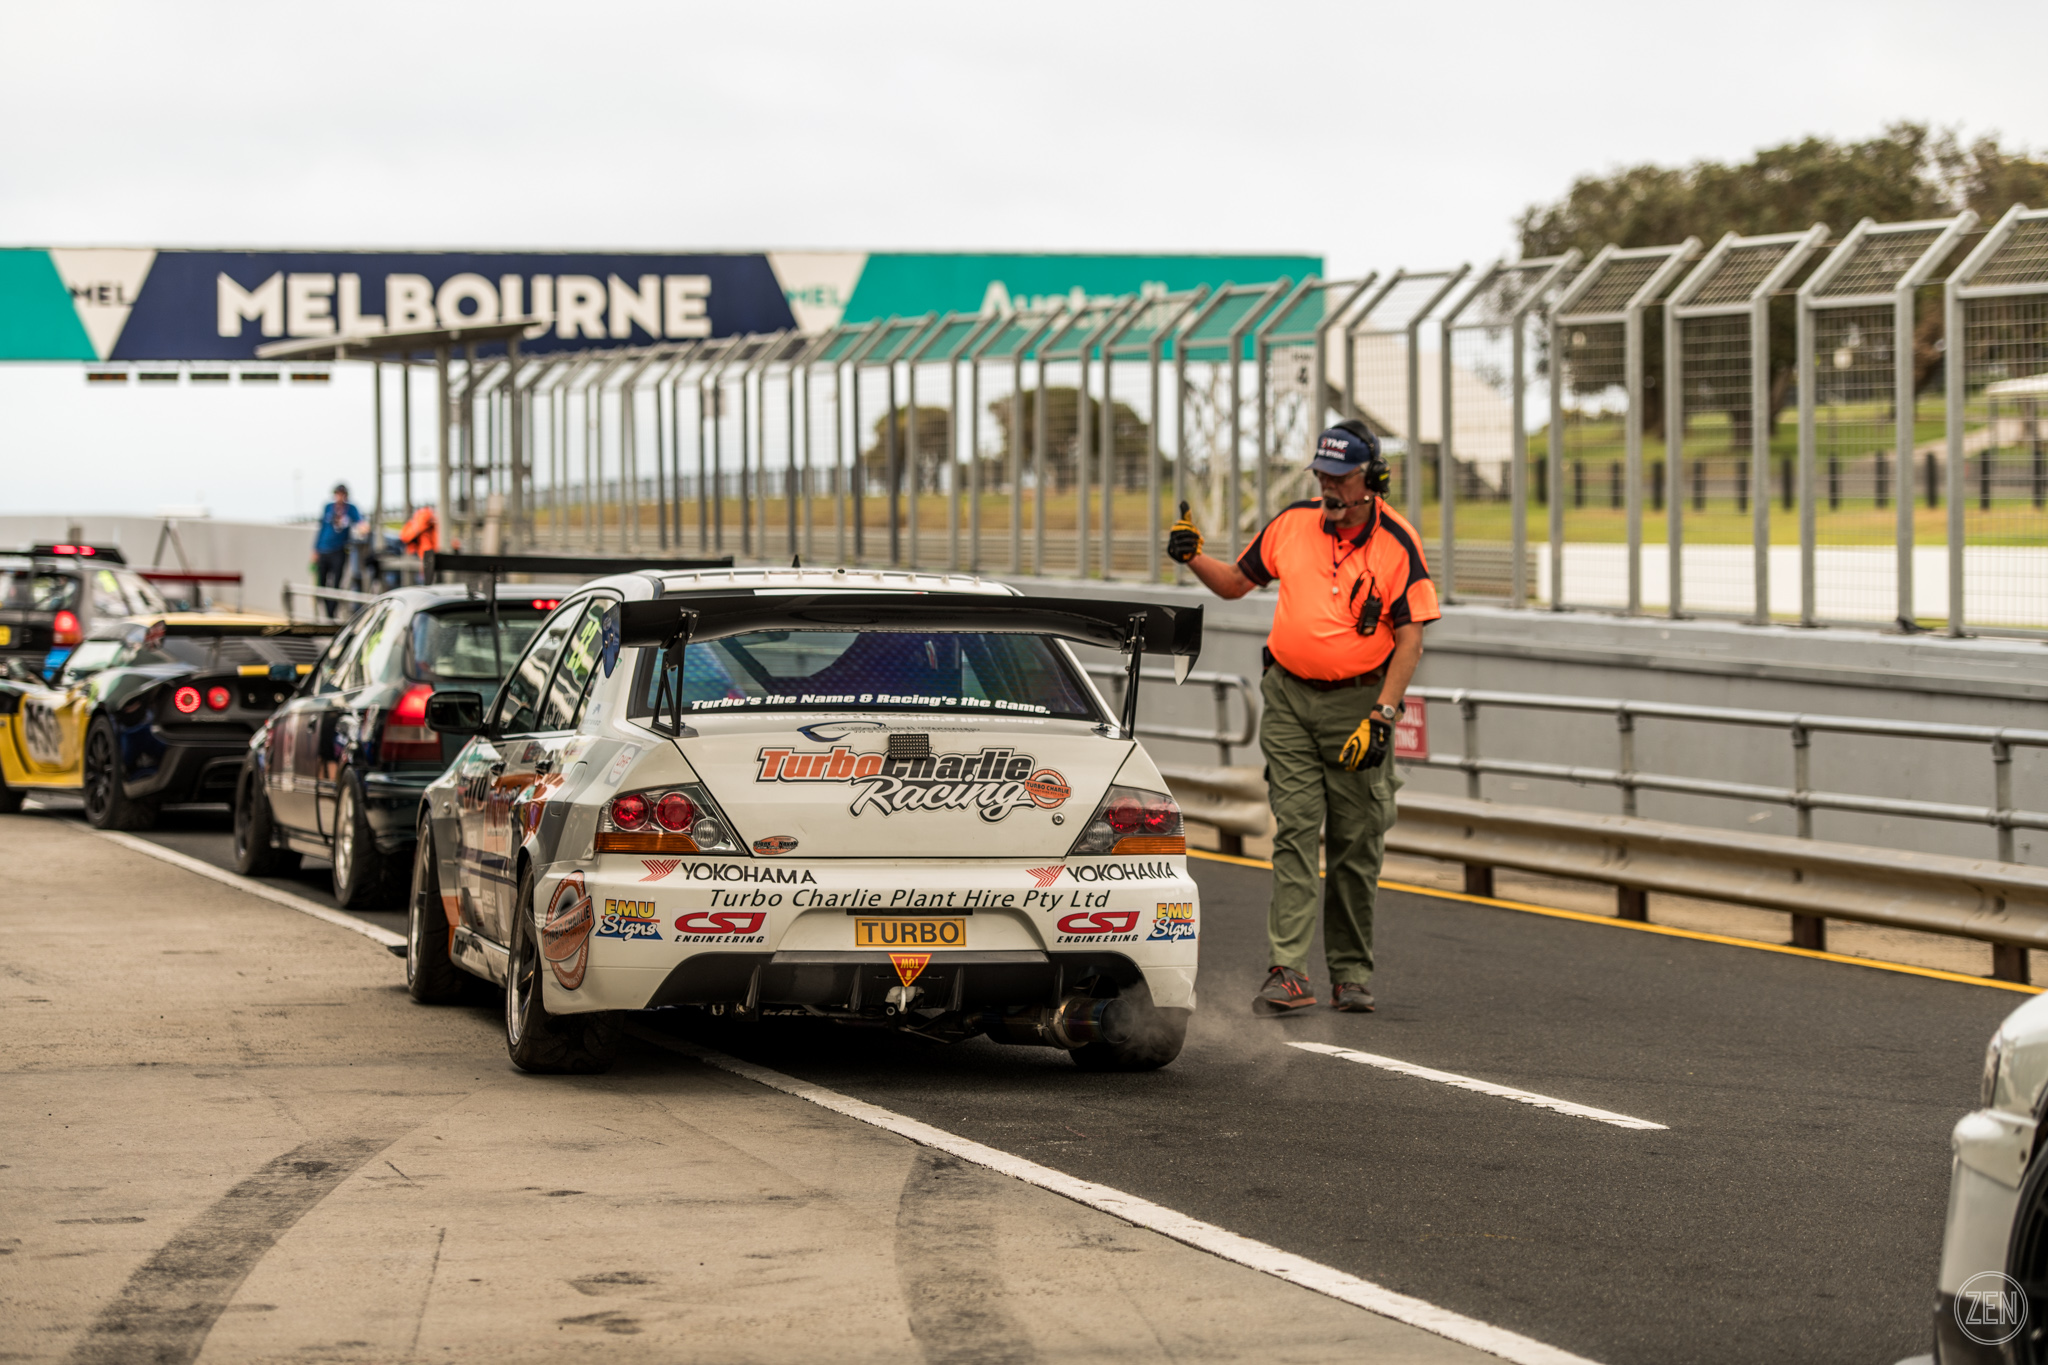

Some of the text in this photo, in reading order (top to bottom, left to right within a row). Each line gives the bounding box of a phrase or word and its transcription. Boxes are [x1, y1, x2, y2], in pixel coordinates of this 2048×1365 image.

[68, 283, 136, 307] MEL
[216, 270, 713, 339] MELBOURNE
[691, 696, 762, 710] Turbo's
[765, 695, 797, 704] the
[800, 694, 856, 703] Name
[876, 694, 957, 707] Racing's
[960, 697, 991, 708] the
[995, 699, 1051, 714] Game.
[850, 773, 1036, 822] Racing
[1026, 782, 1070, 794] TURBO CHARLIE
[681, 862, 817, 884] YOKOHAMA
[1066, 861, 1179, 882] YOKOHAMA
[604, 898, 656, 918] EMU
[711, 888, 1111, 912] Turbo Charlie Plant Hire Pty Ltd
[1156, 902, 1193, 919] EMU
[543, 904, 591, 948] TURBO CHARLIE
[600, 913, 657, 941] Signs
[861, 922, 959, 943] TURBO
[1152, 917, 1195, 943] Signs
[674, 934, 764, 943] ENGINEERING
[1056, 934, 1139, 943] ENGINEERING
[900, 958, 919, 969] TOW
